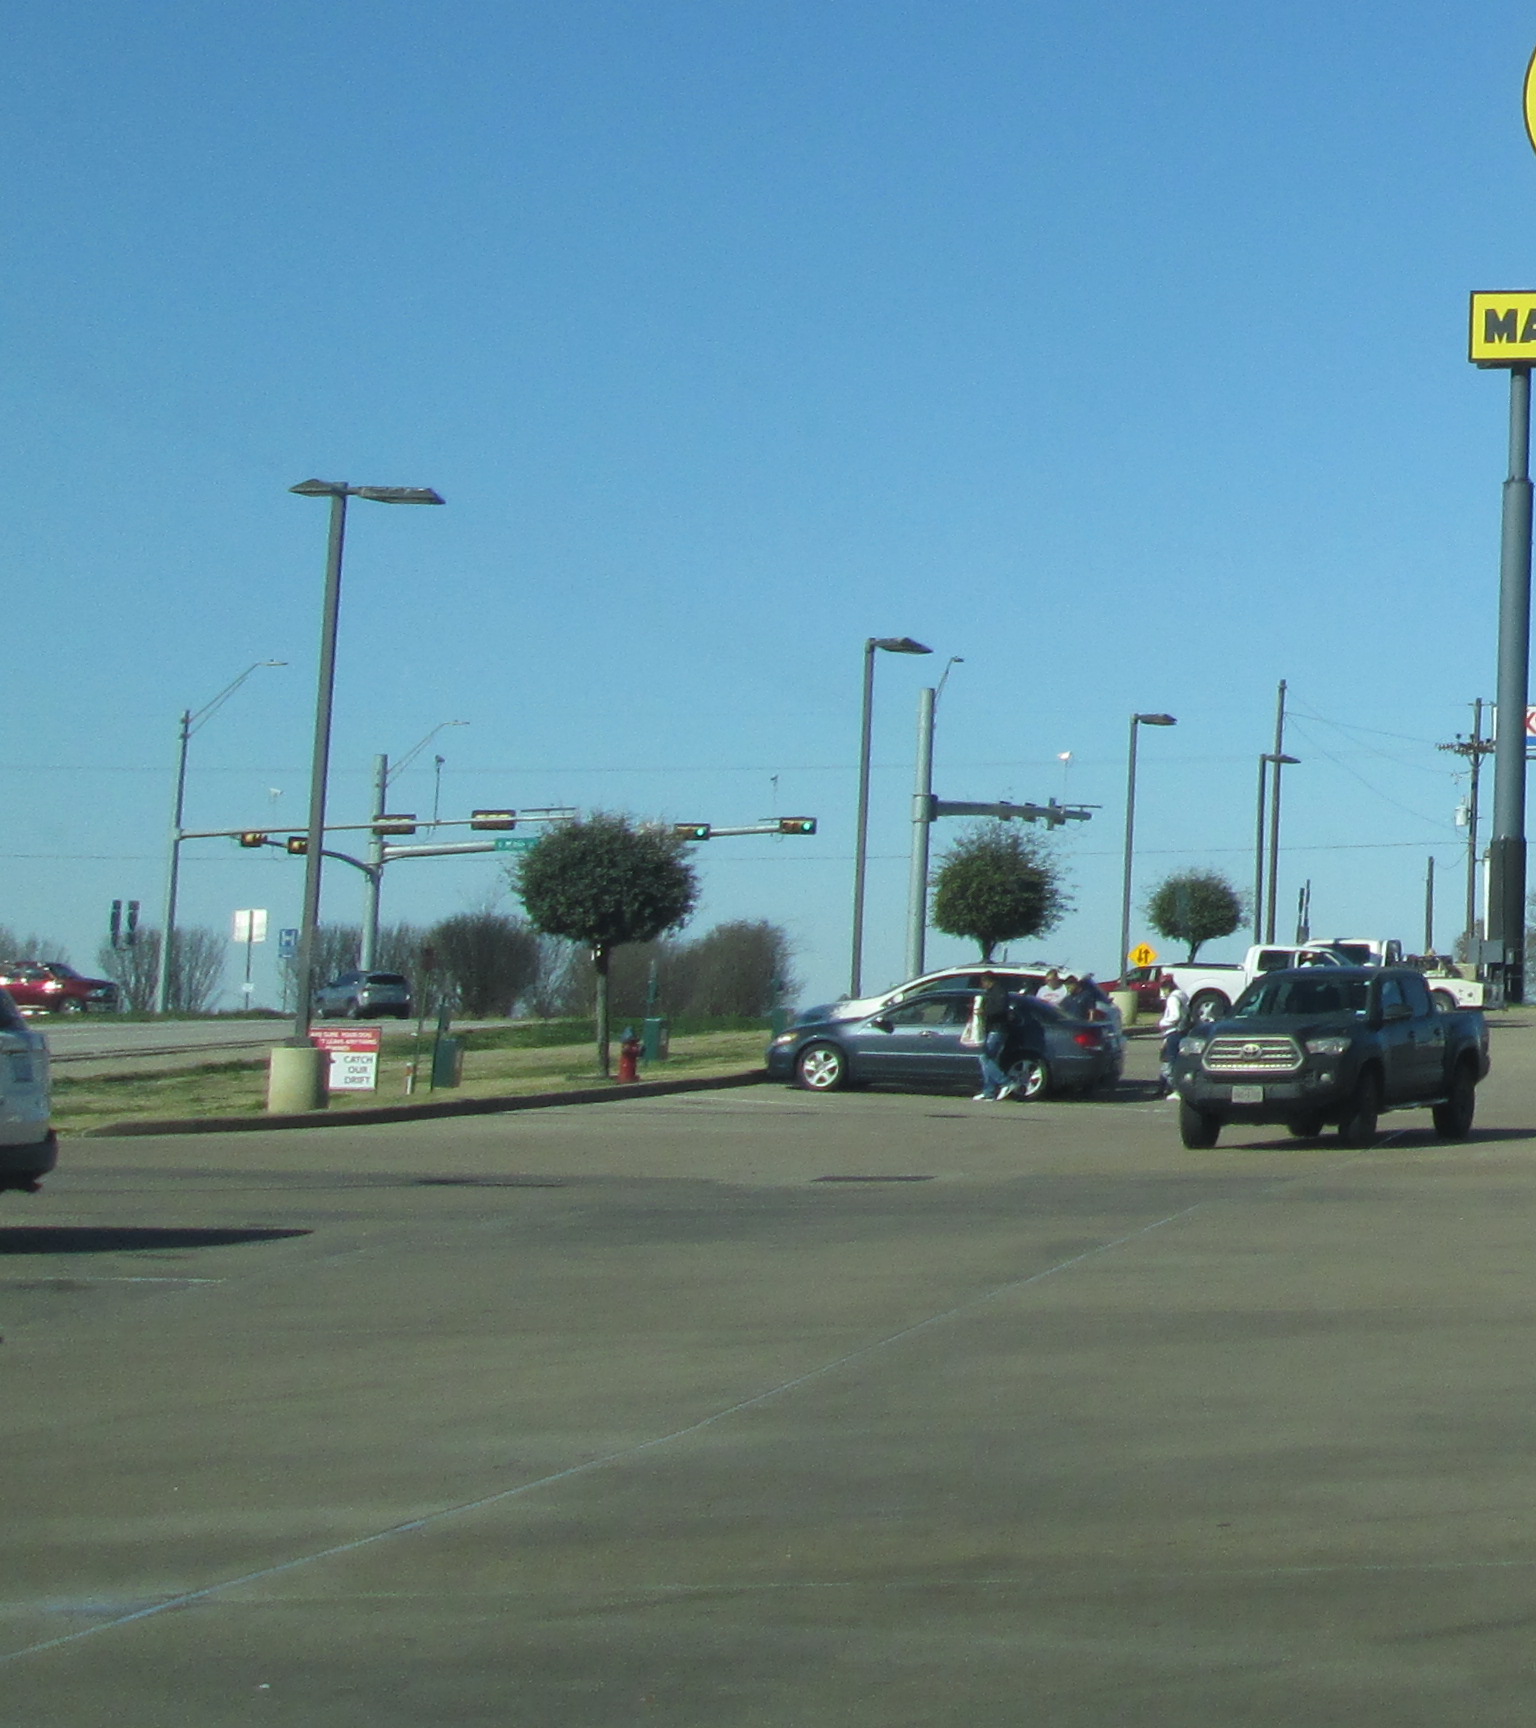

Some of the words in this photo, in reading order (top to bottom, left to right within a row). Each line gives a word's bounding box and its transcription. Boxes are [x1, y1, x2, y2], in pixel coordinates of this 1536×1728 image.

[281, 930, 297, 946] H
[343, 1055, 373, 1064] CATCH
[343, 1076, 371, 1084] DRIFT
